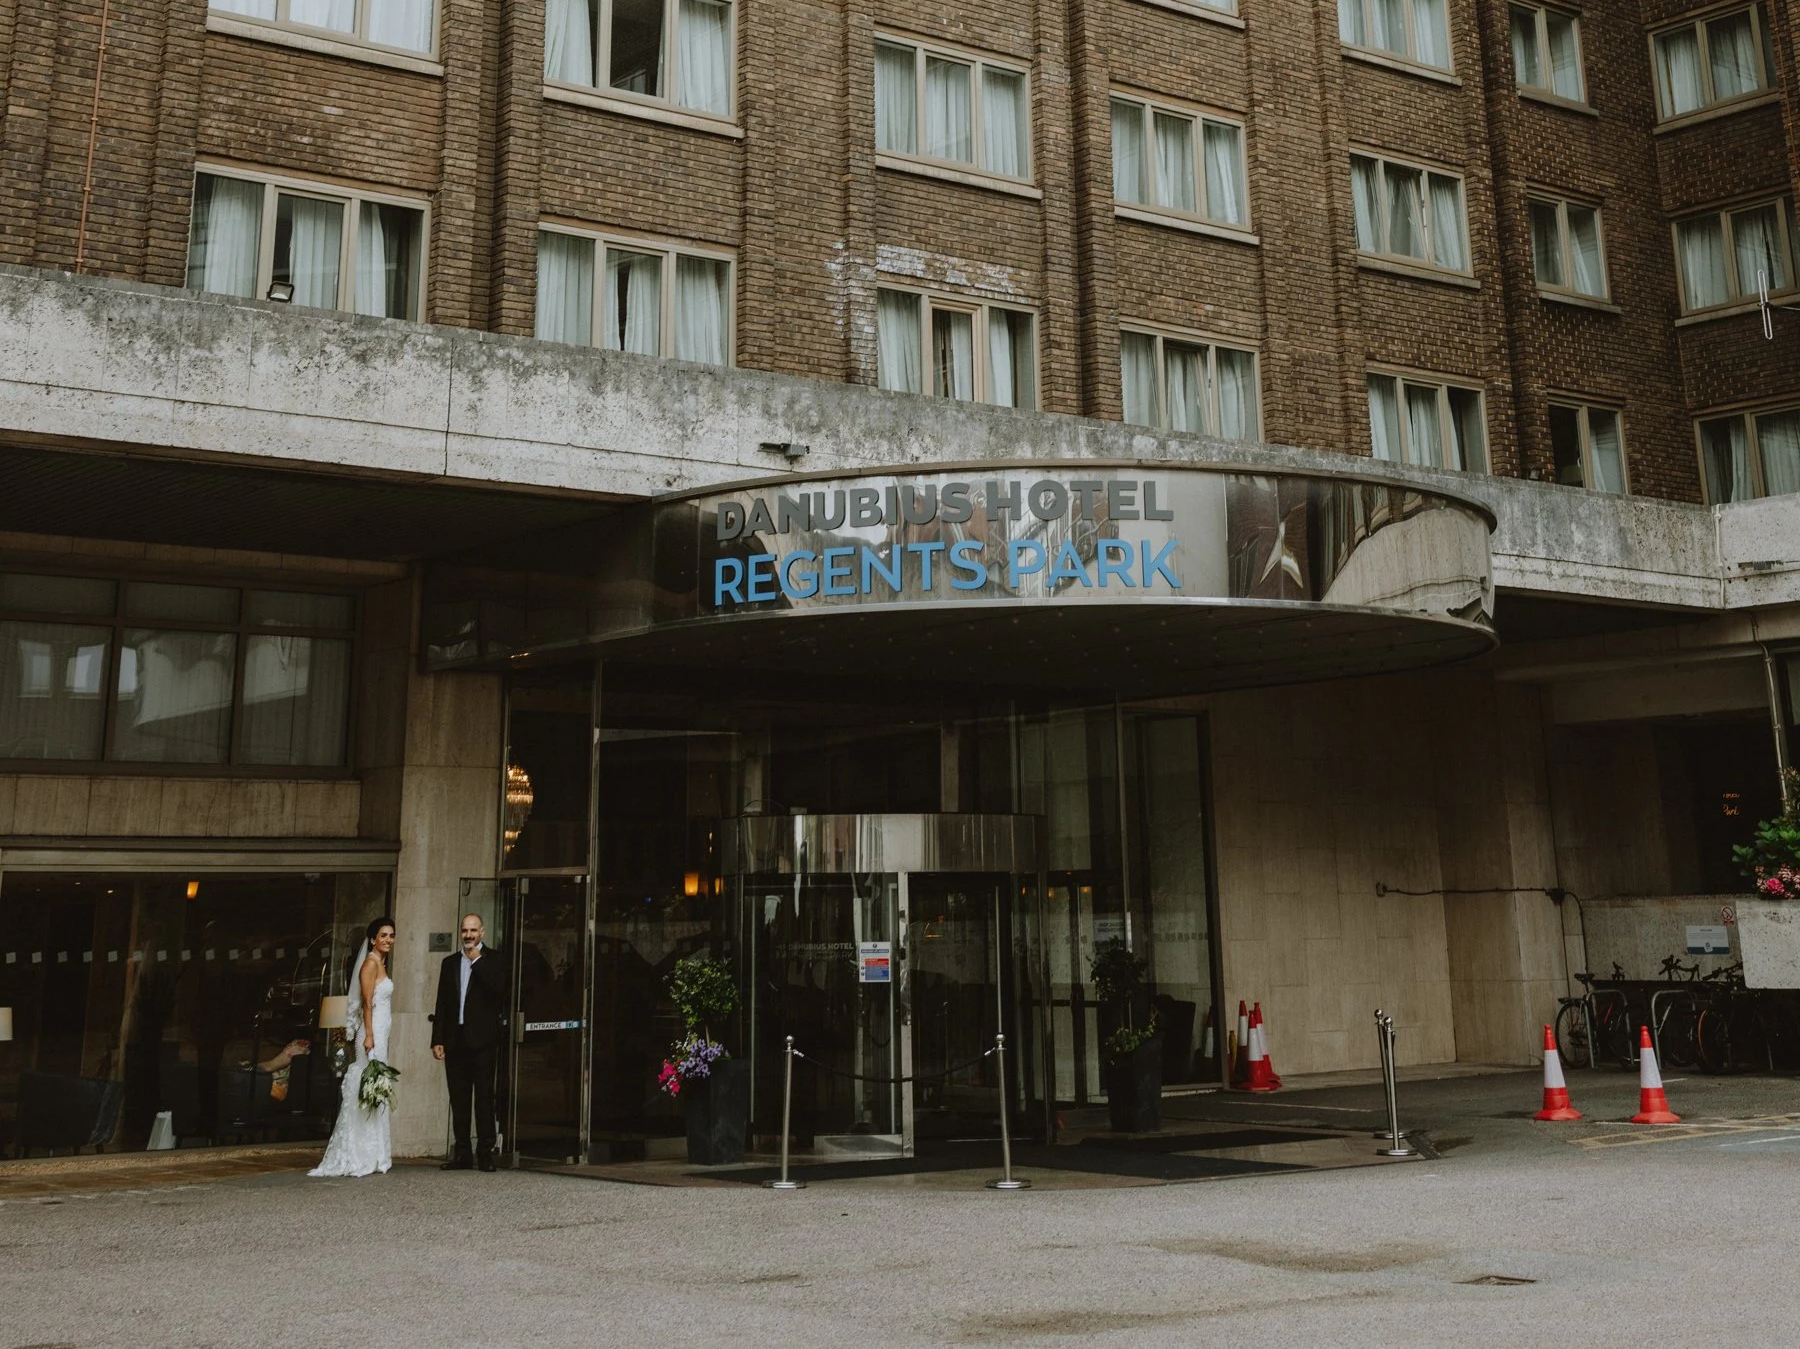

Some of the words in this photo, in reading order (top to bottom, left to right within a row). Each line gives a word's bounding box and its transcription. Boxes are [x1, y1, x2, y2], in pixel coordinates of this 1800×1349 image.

[716, 481, 974, 541] DANUBIUS
[986, 479, 1174, 521] HOTEL
[713, 538, 988, 607] REGENTS
[1008, 538, 1183, 588] PARK
[827, 942, 854, 950] HOTEL
